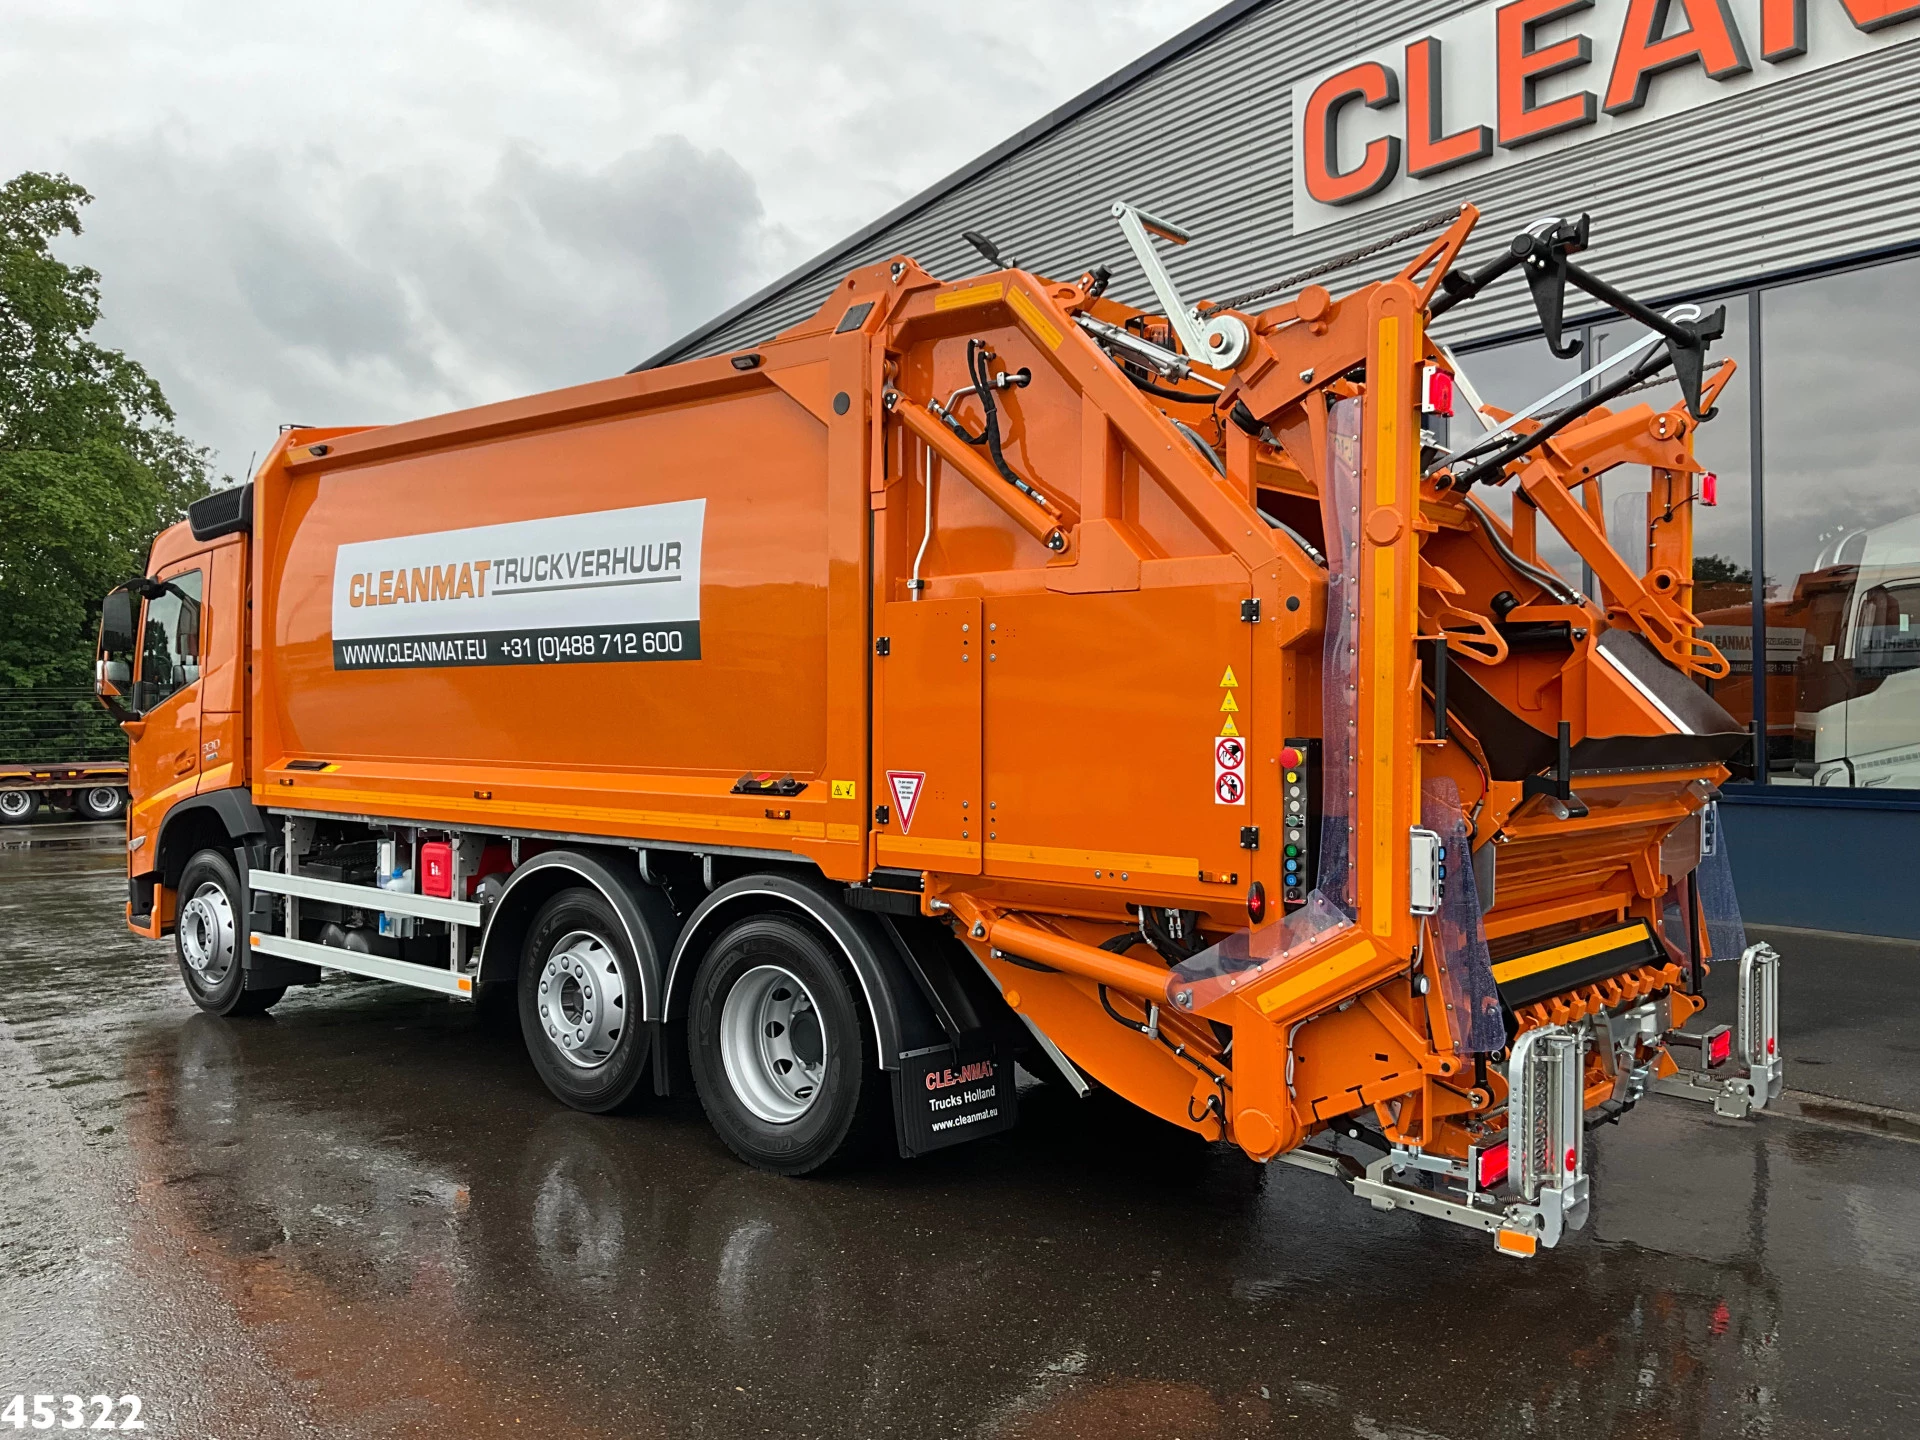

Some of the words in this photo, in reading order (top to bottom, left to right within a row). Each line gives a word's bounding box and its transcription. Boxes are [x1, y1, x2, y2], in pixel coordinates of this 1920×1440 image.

[349, 559, 491, 608] CLEANMAT
[492, 541, 682, 585] TRUCKVERHUUR
[343, 639, 487, 664] WWW.CLEANMAT.EU
[500, 638, 531, 658] +31
[537, 635, 595, 662] (0)488
[601, 633, 637, 655] 712
[643, 631, 682, 653] 600
[1702, 635, 1752, 650] EANMA
[929, 1094, 962, 1111] Trucks
[963, 1084, 996, 1104] Holland
[932, 1108, 998, 1132] www.cleanmat.eu
